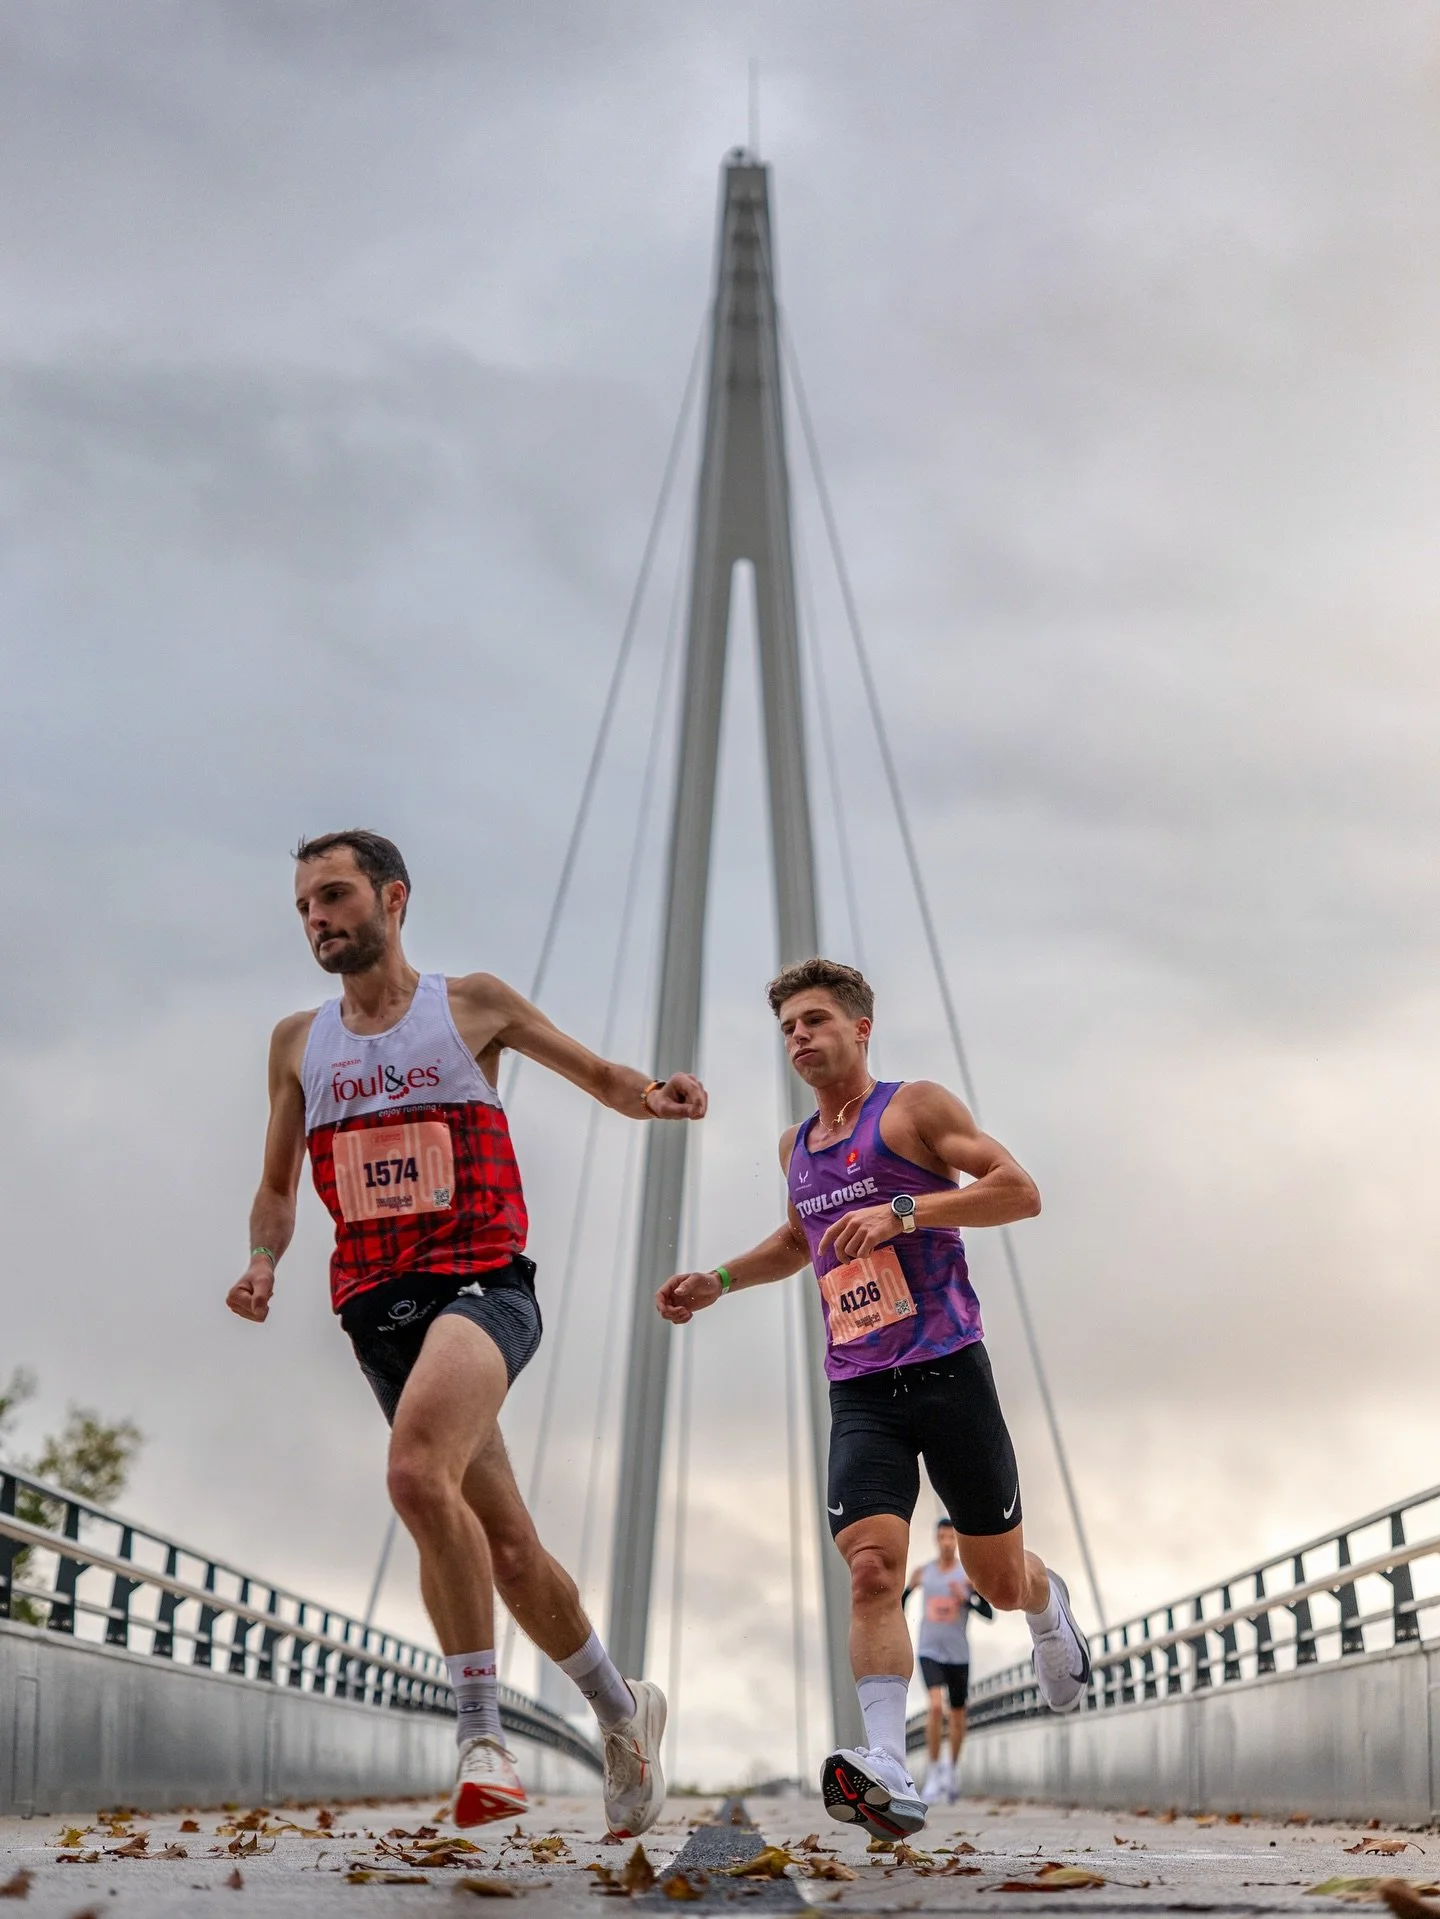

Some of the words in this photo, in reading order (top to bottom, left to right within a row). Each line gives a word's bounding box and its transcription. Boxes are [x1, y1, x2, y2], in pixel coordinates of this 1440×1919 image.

[331, 1058, 362, 1070] magasin
[331, 1064, 440, 1103] foul&es
[378, 1107, 401, 1118] enjoy
[363, 1157, 419, 1188] 1574
[795, 1176, 879, 1219] TOULOUSE
[840, 1281, 881, 1314] 4126
